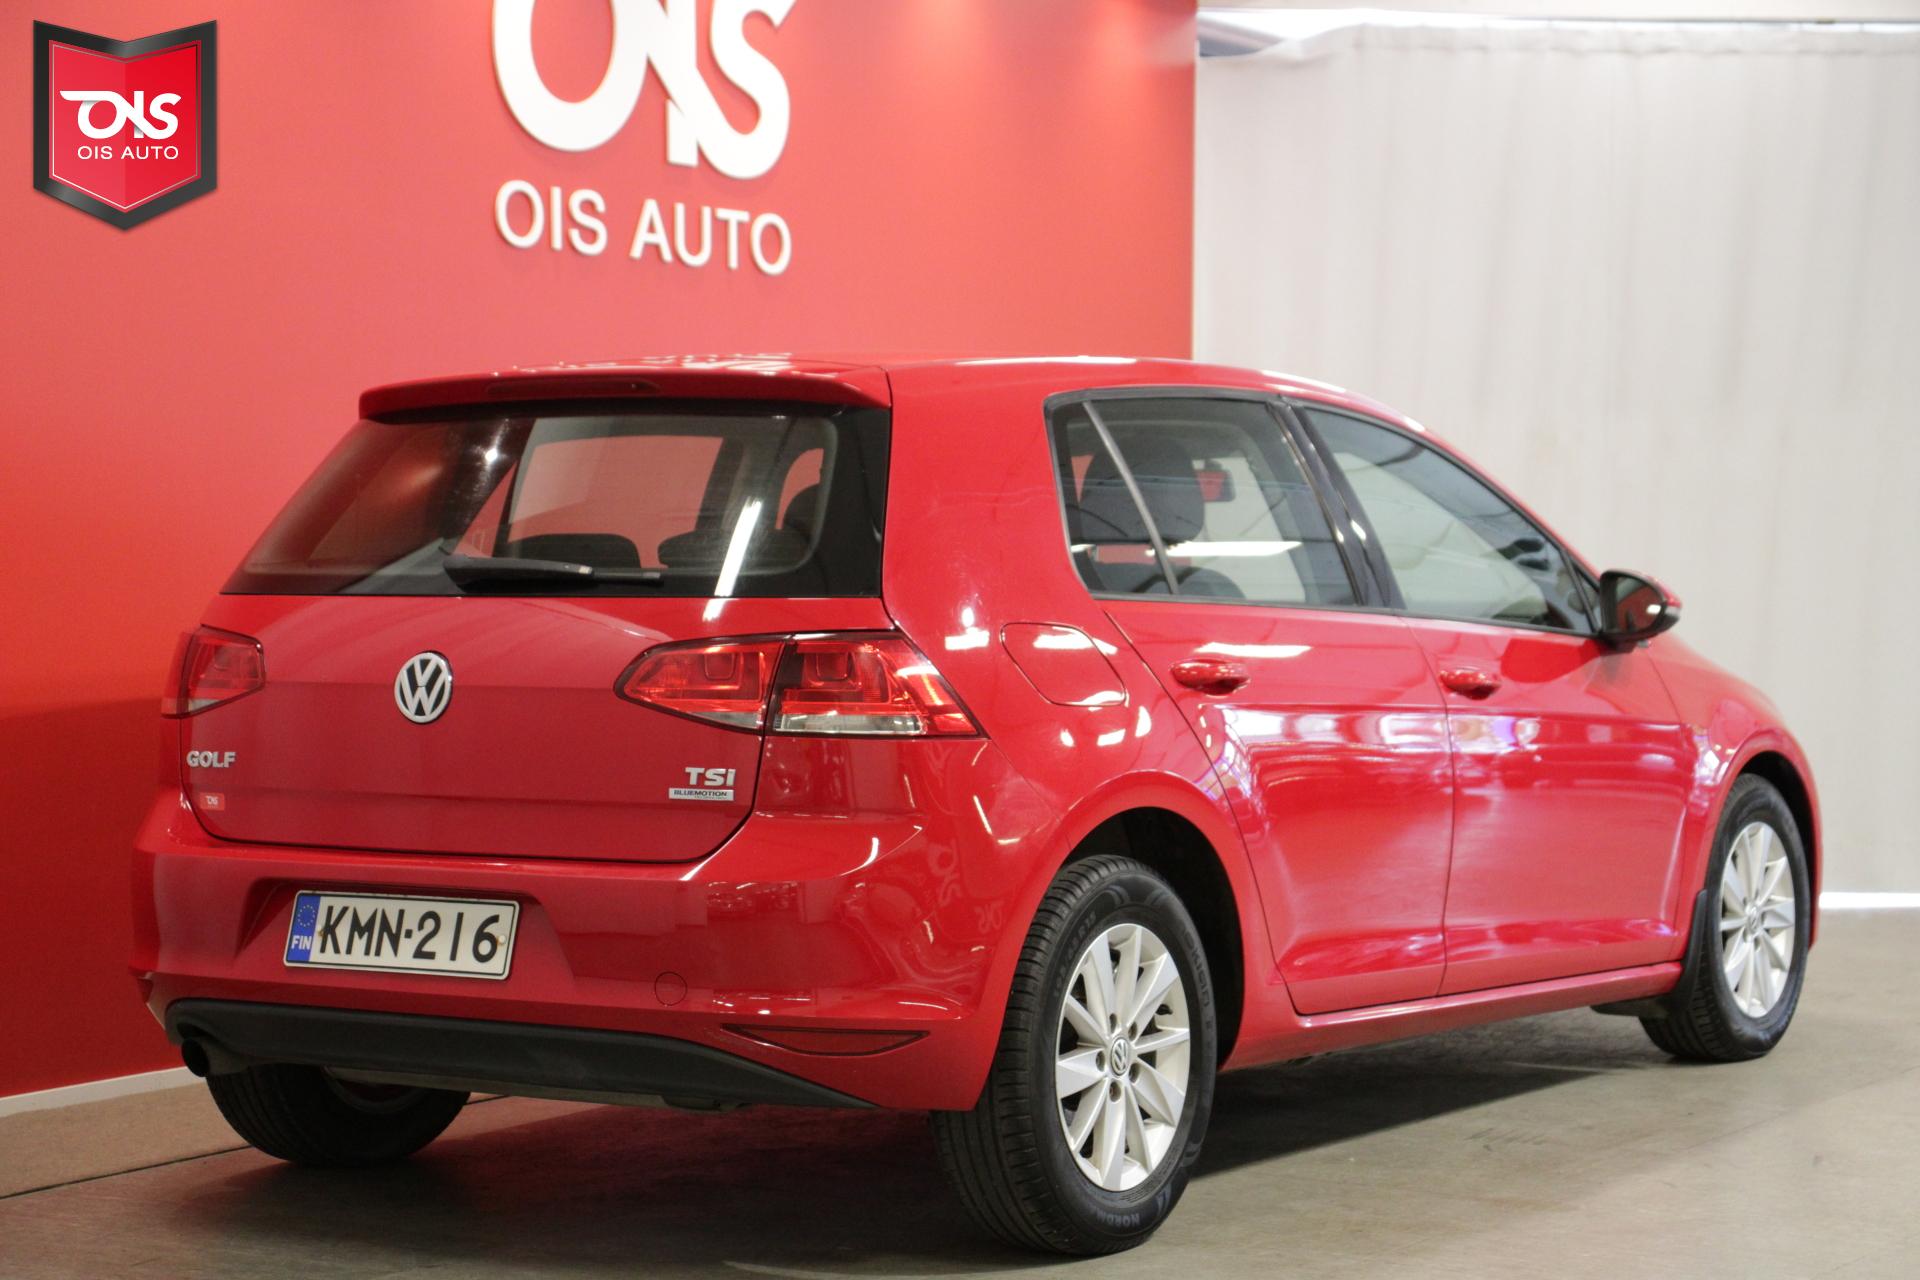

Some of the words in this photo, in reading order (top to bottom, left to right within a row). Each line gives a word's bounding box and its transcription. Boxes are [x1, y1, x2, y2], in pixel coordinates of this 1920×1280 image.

[494, 179, 608, 256] OIS
[628, 197, 792, 276] AUTO
[186, 750, 236, 768] GOLF
[684, 766, 736, 786] TSI
[291, 934, 312, 950] FIN
